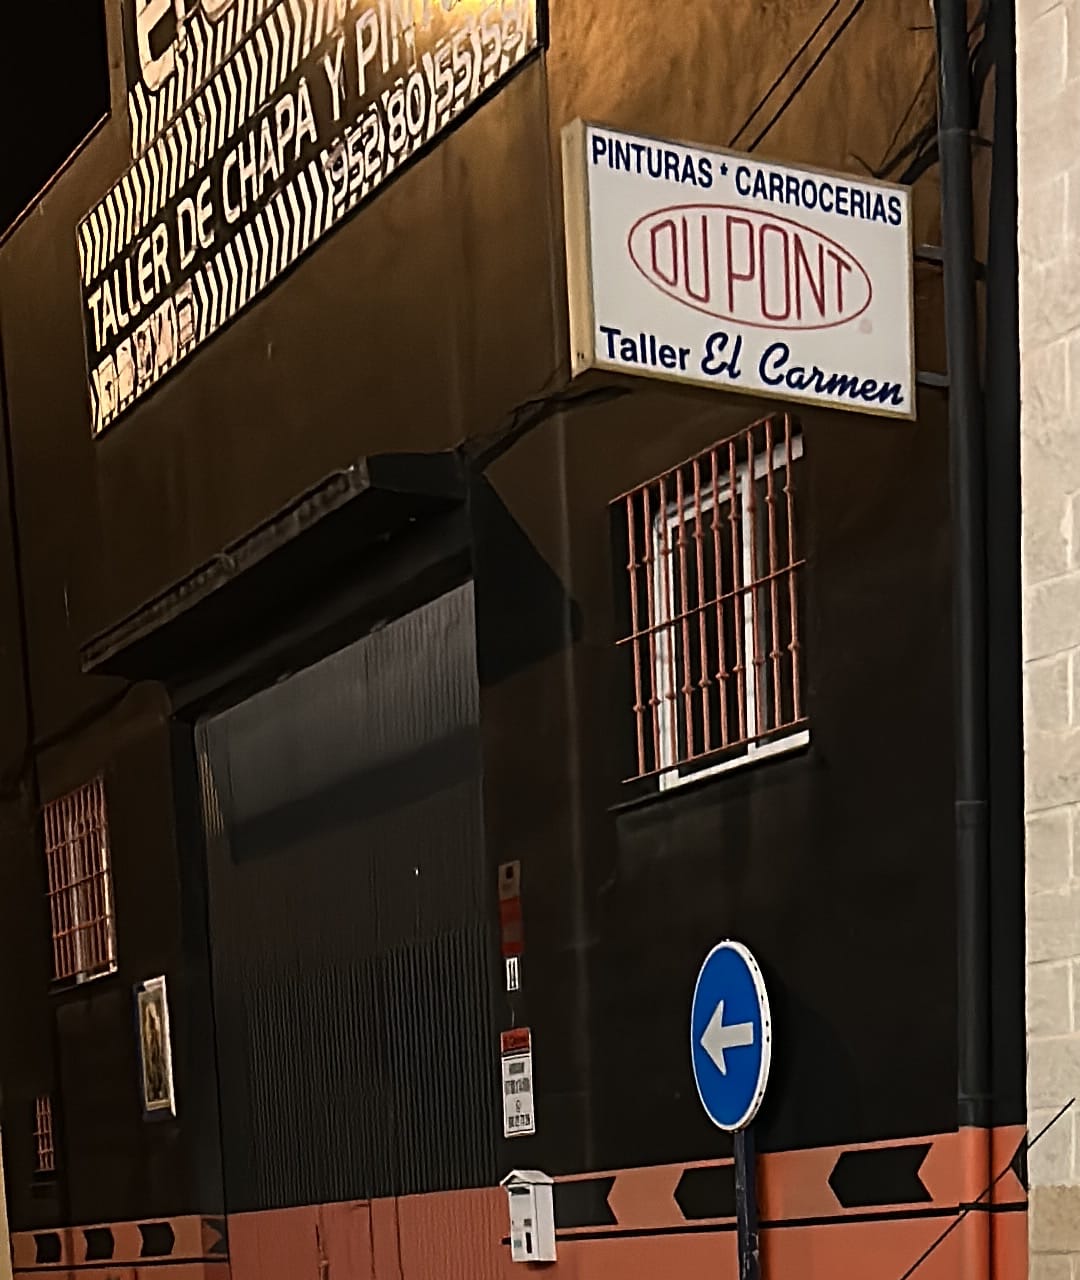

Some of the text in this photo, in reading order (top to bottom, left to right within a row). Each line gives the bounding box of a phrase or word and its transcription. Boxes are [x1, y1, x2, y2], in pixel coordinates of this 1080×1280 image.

[387, 72, 426, 153] 80
[88, 222, 171, 352] TALLER
[176, 176, 215, 270] DE
[222, 76, 318, 224] CHAPA
[323, 35, 346, 121] Y
[591, 135, 902, 226] PINTURAS CARROCERIAS
[600, 325, 904, 405] Taller El Carmen
